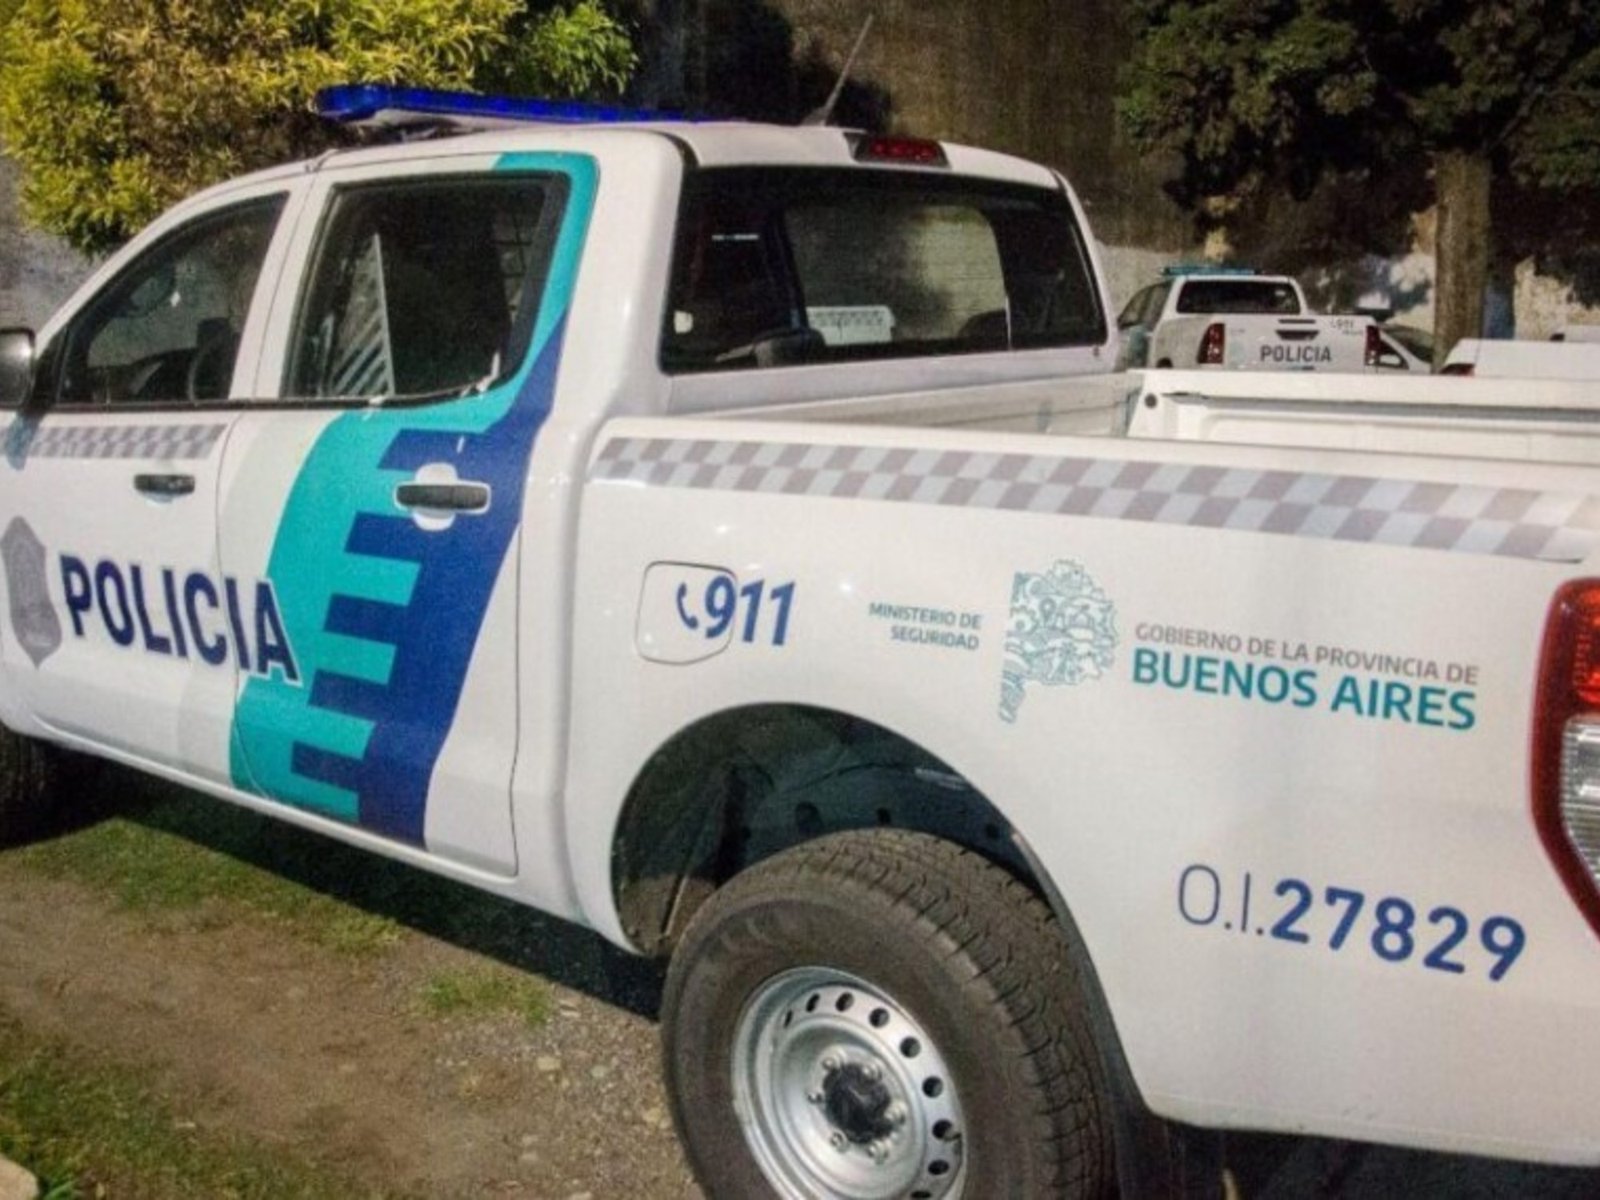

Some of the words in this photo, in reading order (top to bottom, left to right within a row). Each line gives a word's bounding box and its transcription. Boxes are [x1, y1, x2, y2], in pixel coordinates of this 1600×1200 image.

[1260, 345, 1331, 361] POLICIA
[60, 554, 299, 682] POLICIA
[705, 575, 795, 646] 911
[869, 601, 956, 626] MINISTERIO
[960, 612, 982, 629] DE
[890, 625, 979, 650] SEGURIDAD
[1135, 622, 1242, 652] GOBIERNO
[1247, 637, 1276, 658] DE
[1282, 641, 1308, 662] LA
[1315, 645, 1439, 680] PROVINCIA
[1447, 662, 1479, 685] DE
[1132, 648, 1317, 707] BUENOS
[1330, 675, 1476, 730] AIRES
